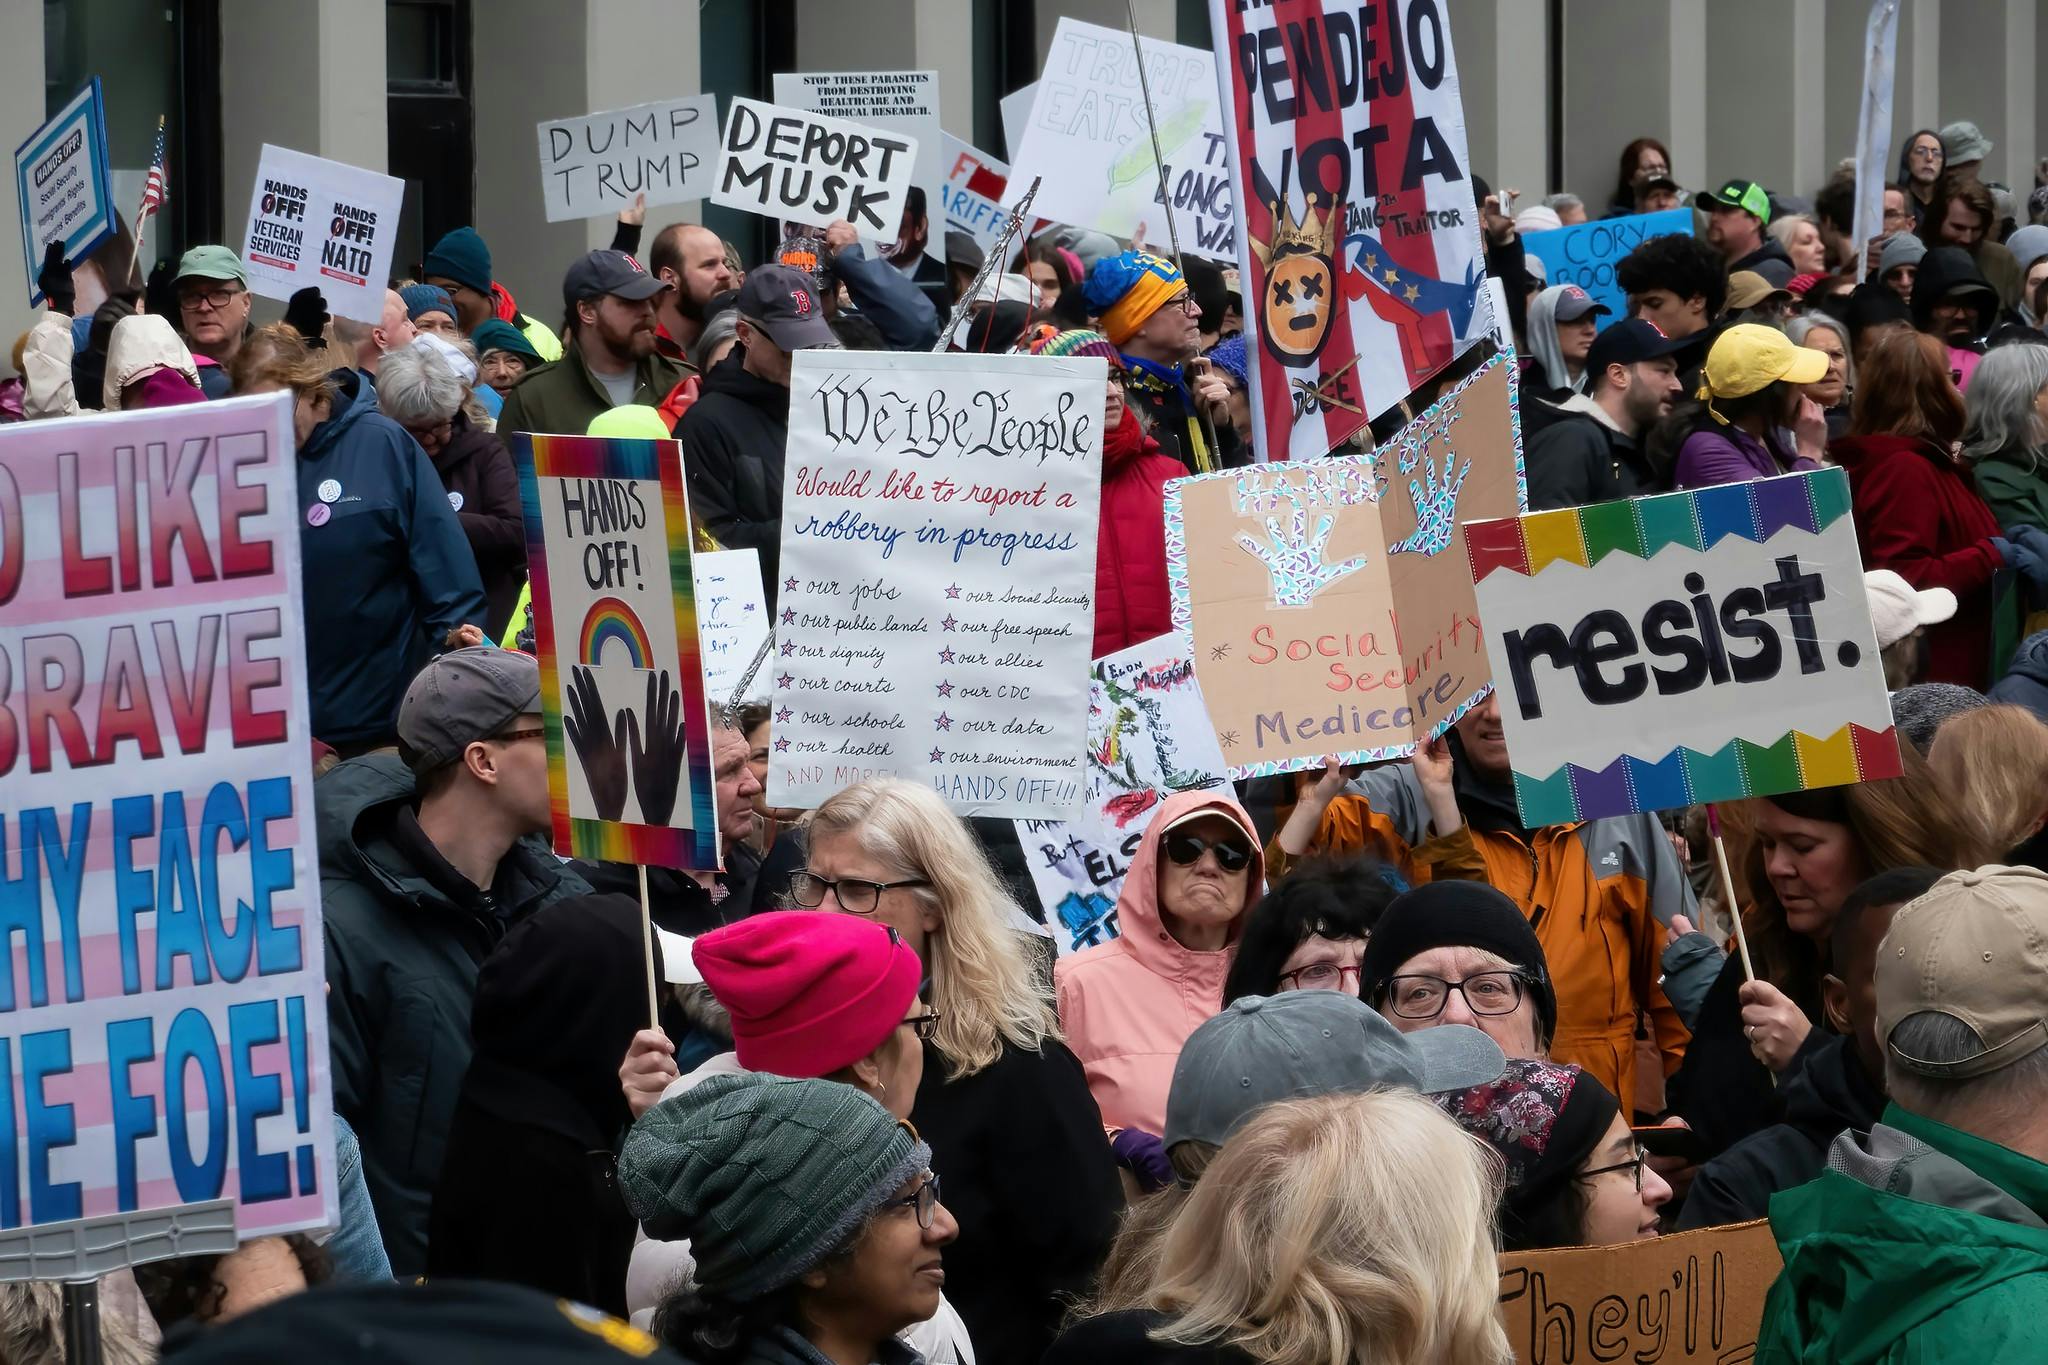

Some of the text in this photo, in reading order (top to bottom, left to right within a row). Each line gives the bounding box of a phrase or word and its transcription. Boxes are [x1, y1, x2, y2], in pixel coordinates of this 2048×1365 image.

[803, 74, 929, 85] STOP THESE PARASITES
[1064, 32, 1206, 99] TRUMP
[1239, 0, 1444, 130] PENDEJO
[817, 85, 916, 96] FROM DESTROYING
[820, 95, 915, 107] HEALTHCARE AND
[872, 106, 931, 116] RESEARCH.
[1038, 81, 1159, 146] EATS
[549, 107, 700, 163] DUMP
[727, 105, 909, 183] DEPORT
[36, 132, 81, 184] HANDS OFF!
[1250, 116, 1464, 221] VOTA
[40, 165, 77, 206] Social Security
[264, 179, 308, 201] HANDS
[554, 151, 700, 206] TRUMP
[721, 156, 890, 231] MUSK
[1154, 164, 1232, 221] LONG
[261, 193, 306, 223] OFF!
[333, 202, 378, 225] HANDS
[1389, 208, 1465, 238] TRAITOR
[250, 235, 301, 261] SERVICES
[254, 218, 303, 246] VETERAN
[330, 216, 375, 246] OFF!
[1564, 221, 1648, 265] CORY
[321, 239, 373, 276] NATO
[811, 373, 1093, 467] We the People
[560, 477, 647, 539] HANDS
[795, 466, 1079, 516] Would like to report a
[57, 430, 274, 600] LIKE
[795, 509, 1079, 566] robbery in progress
[583, 540, 645, 592] OFF!
[806, 578, 902, 611] our jobs
[965, 585, 1091, 611] our Social Security
[801, 613, 928, 637] our public lands
[960, 618, 1073, 645] our free speech
[1248, 608, 1403, 665] Social
[1503, 554, 1862, 721] resist.
[799, 645, 886, 669] our dignity
[958, 652, 1044, 668] our allies
[1326, 612, 1484, 692] Security
[799, 676, 896, 693] our courts
[960, 685, 1030, 700] our CDC
[801, 711, 906, 730] our schools
[962, 716, 1054, 735] our data
[1256, 672, 1465, 749] Medicare
[796, 738, 894, 757] our health
[950, 749, 1078, 768] our environment
[787, 766, 824, 788] AND
[935, 774, 1077, 806] HANDS OFF!!!
[112, 775, 304, 996] FACE
[0, 995, 317, 1228] E FOE!
